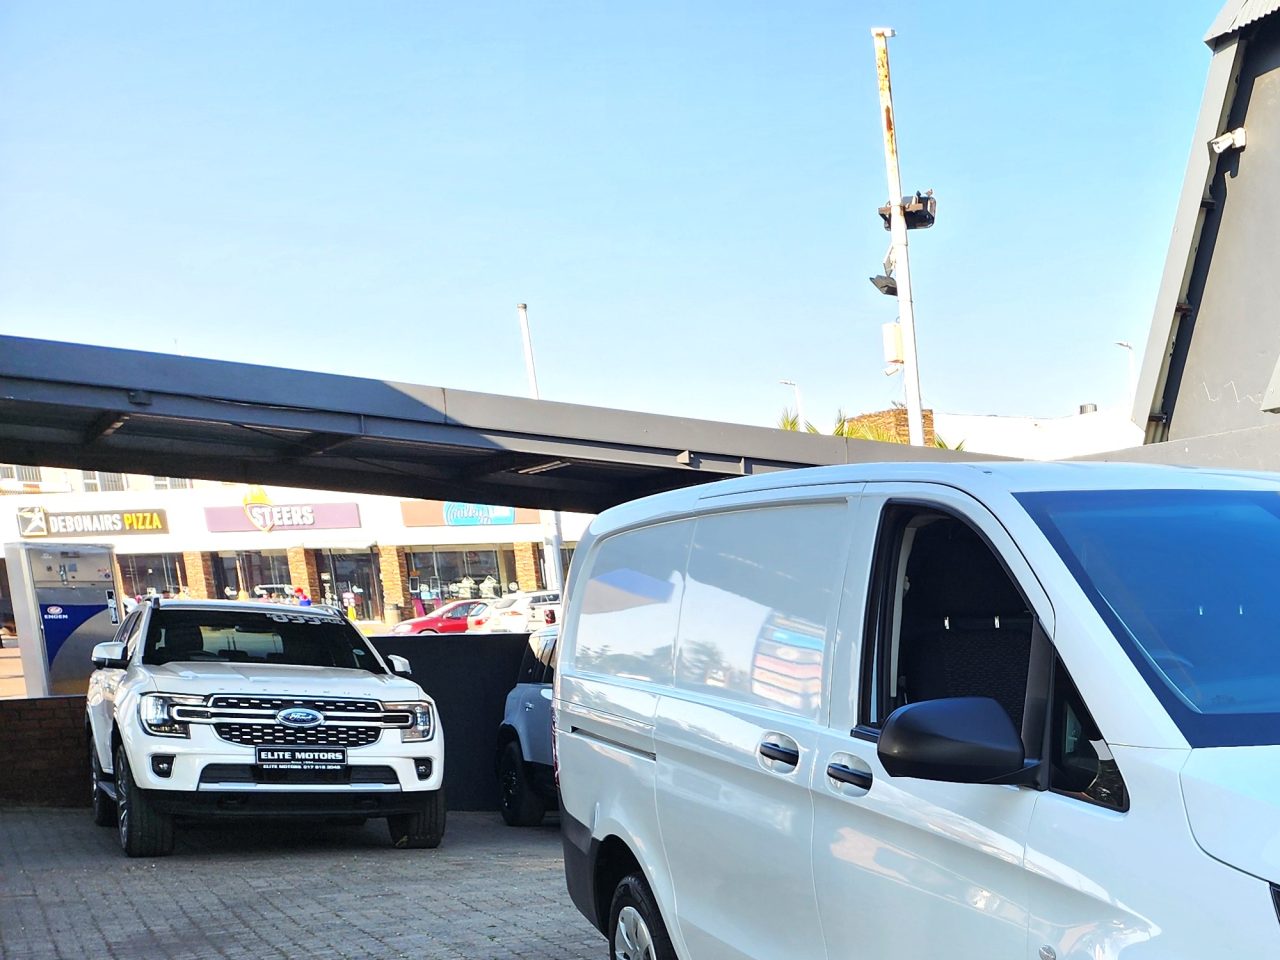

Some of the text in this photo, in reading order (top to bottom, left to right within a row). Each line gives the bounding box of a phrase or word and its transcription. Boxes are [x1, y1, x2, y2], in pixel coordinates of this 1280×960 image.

[49, 512, 162, 533] DEBONAIRS PIZZA
[251, 506, 315, 527] STEERS
[260, 751, 343, 760] ELITE MOTORS
